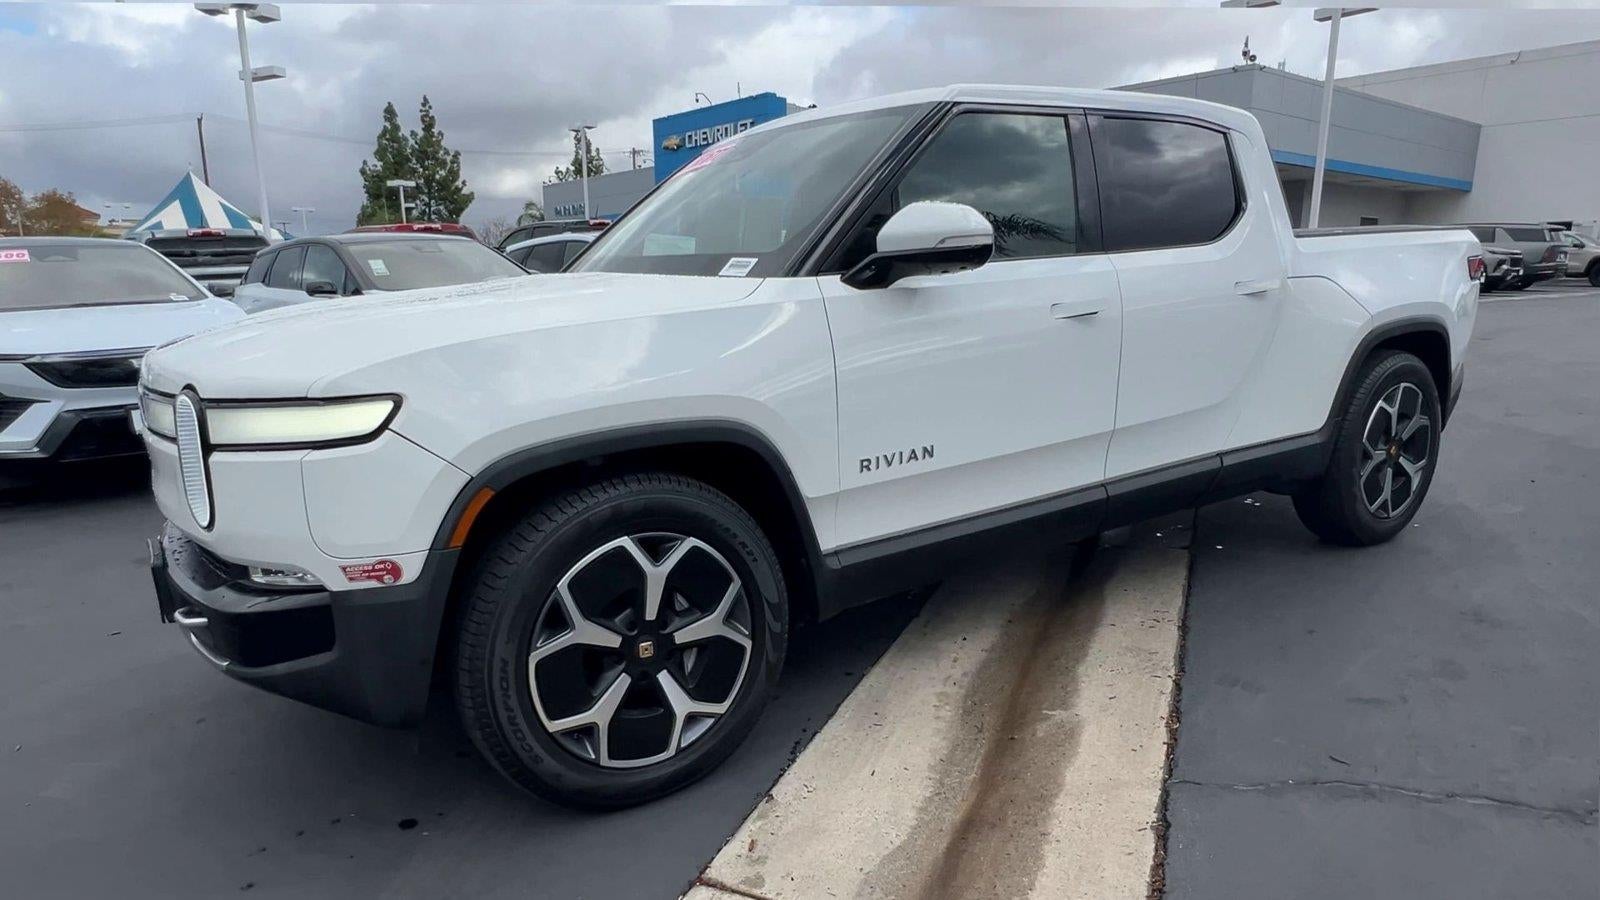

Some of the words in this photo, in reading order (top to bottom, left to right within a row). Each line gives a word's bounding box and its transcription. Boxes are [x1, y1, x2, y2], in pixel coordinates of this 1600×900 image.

[685, 119, 754, 148] CHEVROLET
[859, 445, 934, 474] RIVIAN
[500, 657, 544, 765] SCORPION
